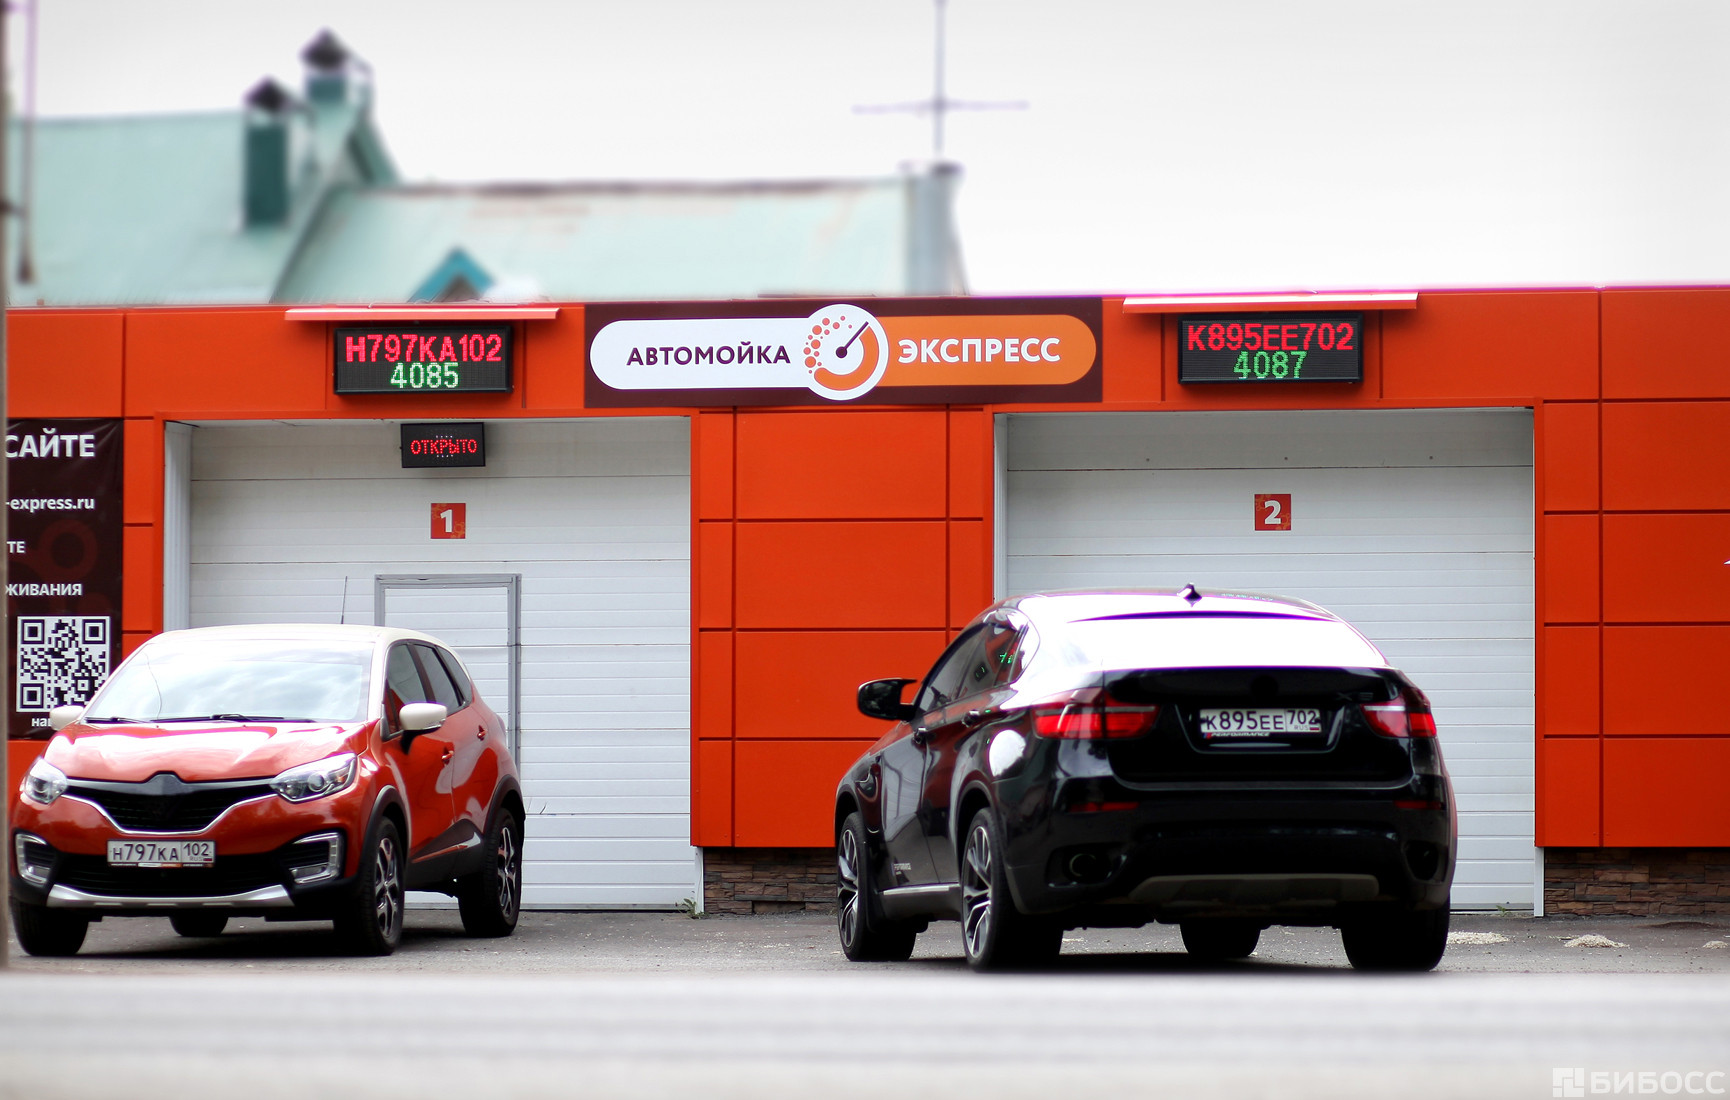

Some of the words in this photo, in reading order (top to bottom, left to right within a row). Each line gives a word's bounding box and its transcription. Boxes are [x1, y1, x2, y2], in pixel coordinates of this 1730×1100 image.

[345, 334, 502, 362] Н797КА102
[1188, 323, 1354, 350] К895ЕЕ702
[626, 341, 791, 366] АВТОМОЙКА
[898, 337, 1061, 364] ЭКСПРЕСС
[390, 362, 459, 388] 4085
[1233, 351, 1308, 379] 4087
[410, 439, 477, 454] ОТКРЫТО
[440, 509, 453, 533] 1
[1264, 500, 1281, 524] 2
[31, 717, 52, 727] на
